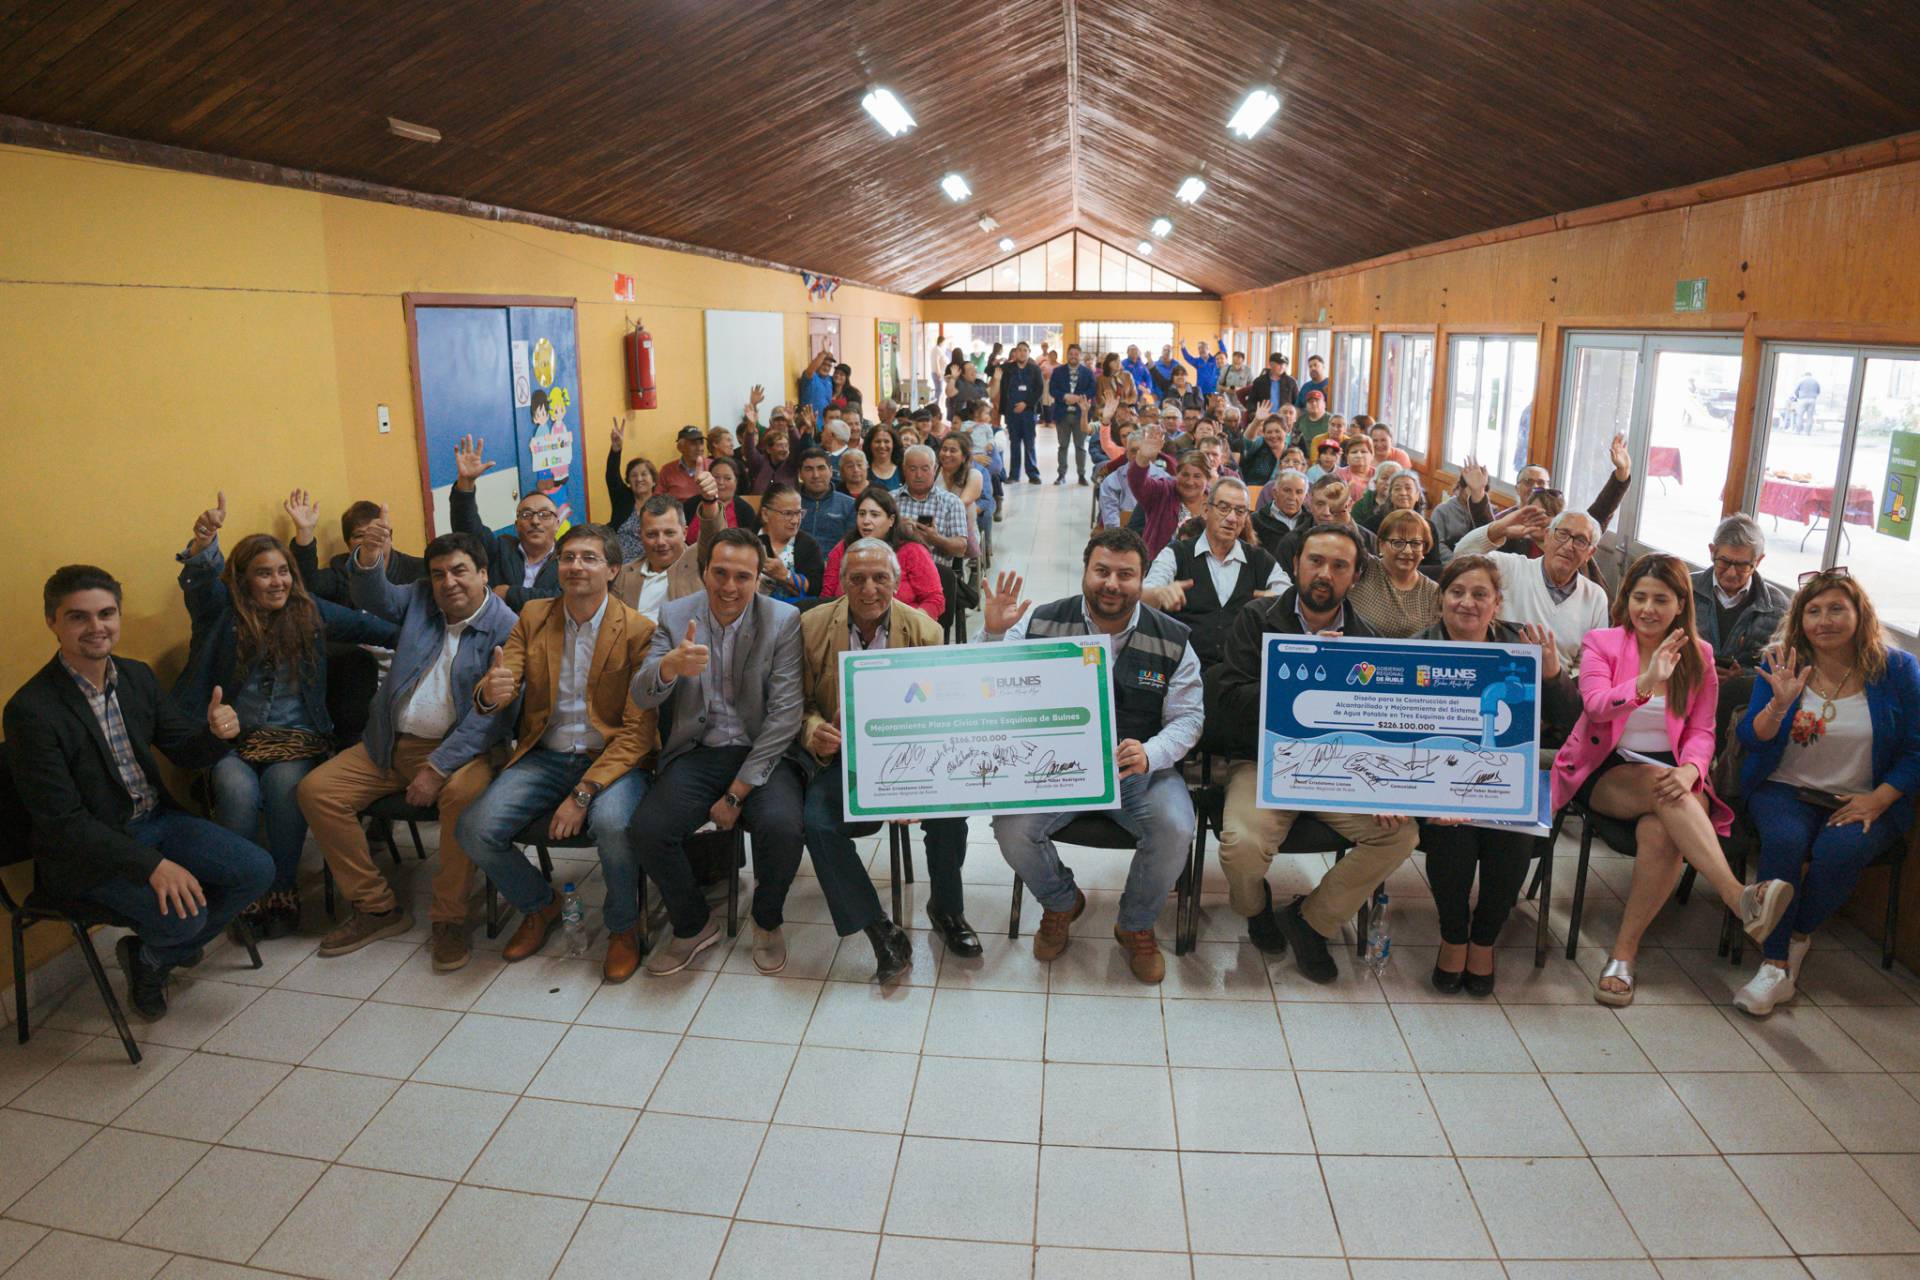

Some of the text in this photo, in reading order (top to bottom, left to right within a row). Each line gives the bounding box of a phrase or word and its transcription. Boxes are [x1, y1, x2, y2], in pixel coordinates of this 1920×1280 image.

[1432, 667, 1477, 679] BULNES
[996, 675, 1042, 688] BULNES
[870, 722, 927, 733] Mejoramiento
[928, 720, 951, 728] Plaza
[981, 717, 998, 725] Tres
[1000, 715, 1037, 726] Esquinas
[1039, 714, 1050, 722] de
[1052, 713, 1080, 721] Bulnes
[1378, 721, 1436, 731] $226.100.000
